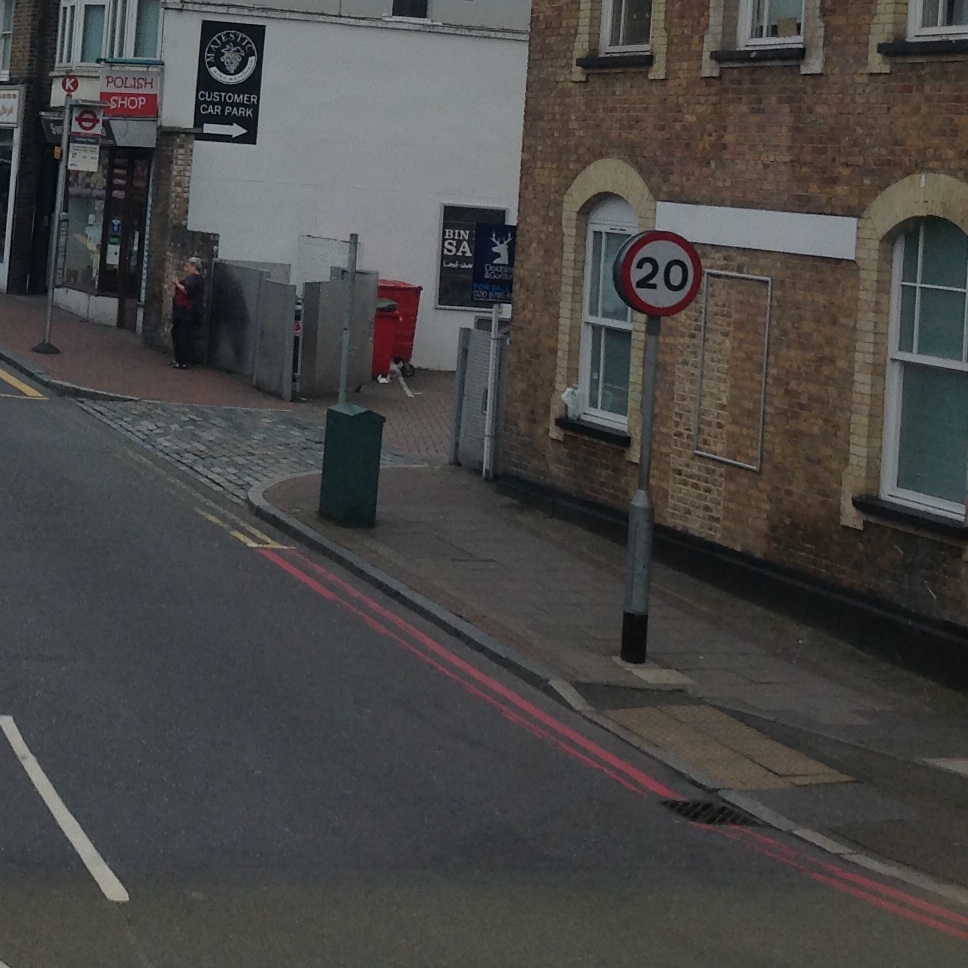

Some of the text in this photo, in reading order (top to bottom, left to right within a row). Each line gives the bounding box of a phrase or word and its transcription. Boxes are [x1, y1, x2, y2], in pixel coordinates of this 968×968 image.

[206, 32, 255, 63] MAJESTIC
[65, 78, 75, 90] K
[106, 76, 154, 90] POLISH
[109, 95, 147, 110] SHOP
[198, 90, 258, 105] CUSTOMER
[200, 104, 254, 118] CAR PARK
[443, 228, 470, 240] BIN
[443, 239, 473, 257] SA
[636, 257, 689, 292] 20
